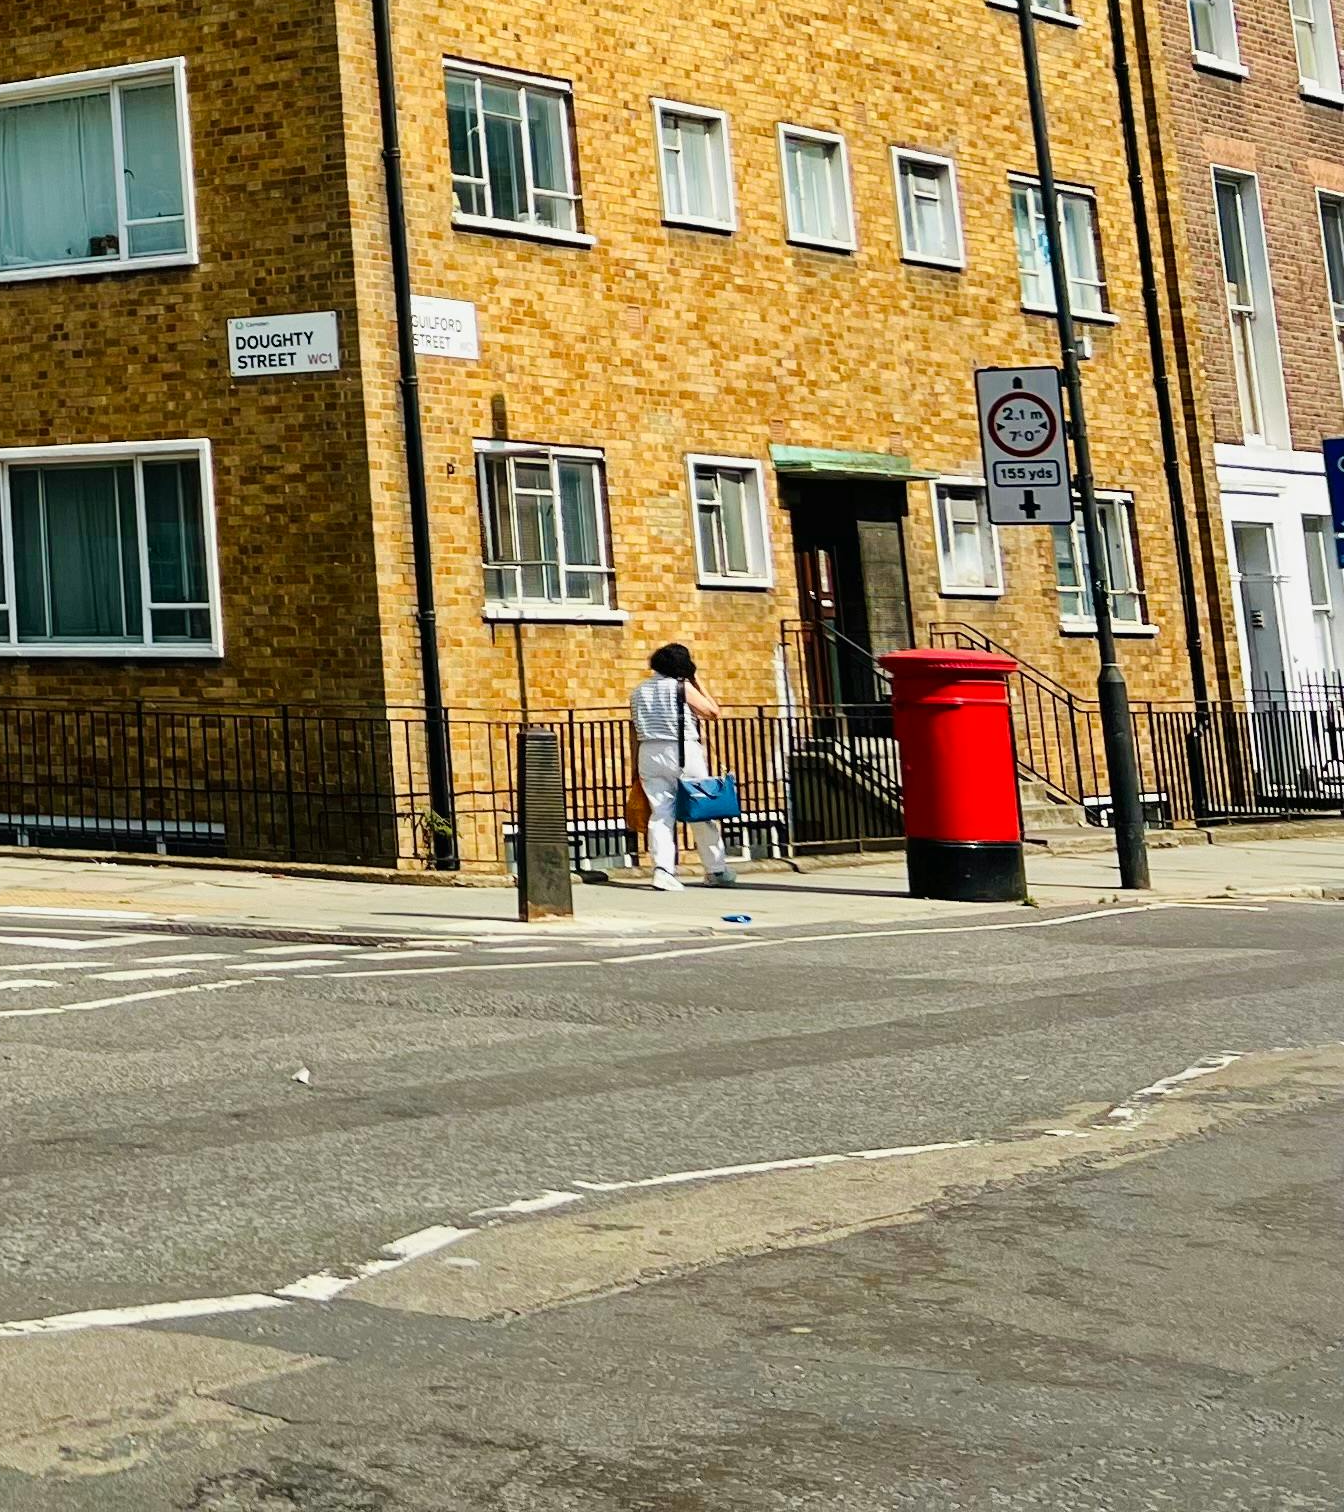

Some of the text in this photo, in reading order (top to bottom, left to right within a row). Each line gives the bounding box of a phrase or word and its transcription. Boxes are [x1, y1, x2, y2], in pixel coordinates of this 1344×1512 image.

[411, 314, 463, 333] GUILFORD
[235, 331, 314, 350] DOUGHTY
[412, 333, 451, 350] STREET
[237, 352, 333, 369] STREET WC1
[1002, 407, 1043, 421] 2.1 m
[1000, 467, 1053, 481] 155 yds
